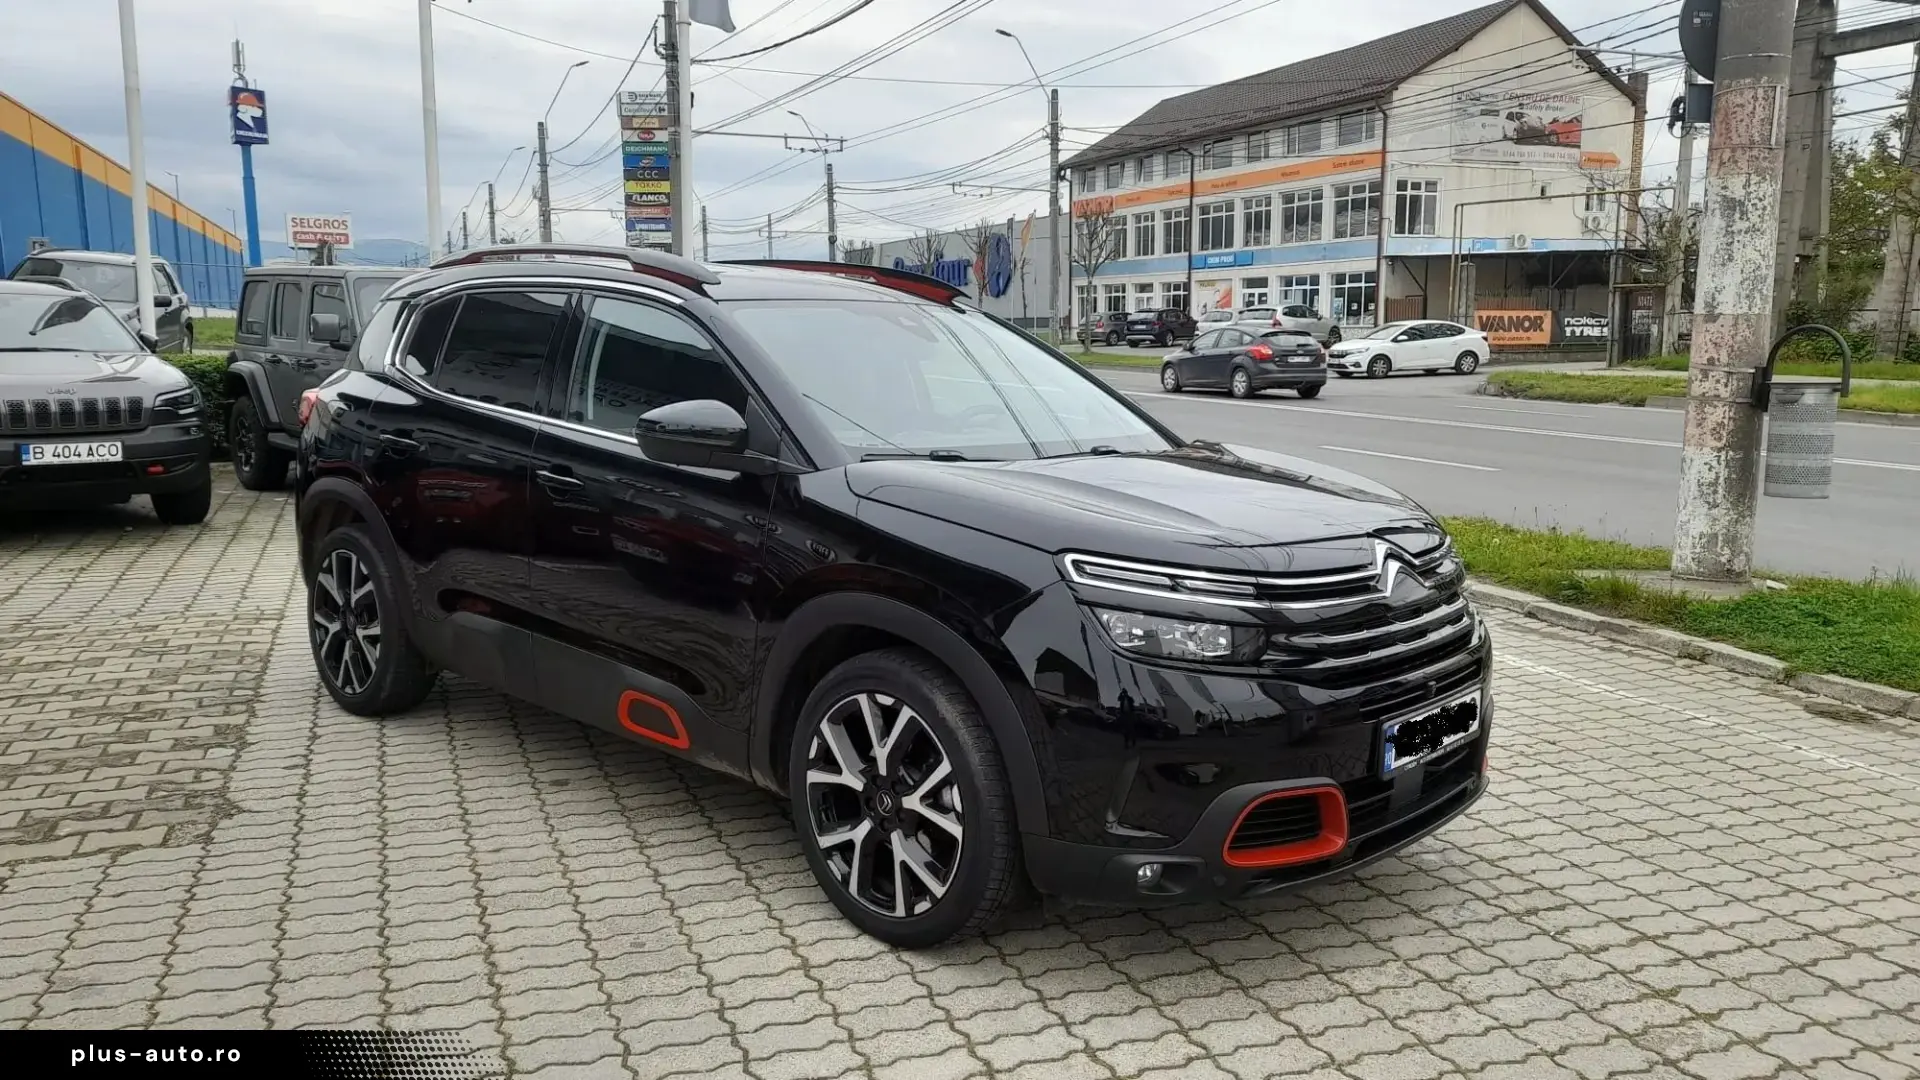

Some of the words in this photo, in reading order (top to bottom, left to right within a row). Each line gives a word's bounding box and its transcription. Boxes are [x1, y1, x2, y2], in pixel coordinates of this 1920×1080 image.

[637, 170, 659, 178] CCC
[291, 217, 349, 230] SELGROS
[1478, 315, 1546, 333] VIANOR
[32, 446, 45, 460] B
[52, 445, 82, 459] 404
[86, 443, 119, 458] ACO
